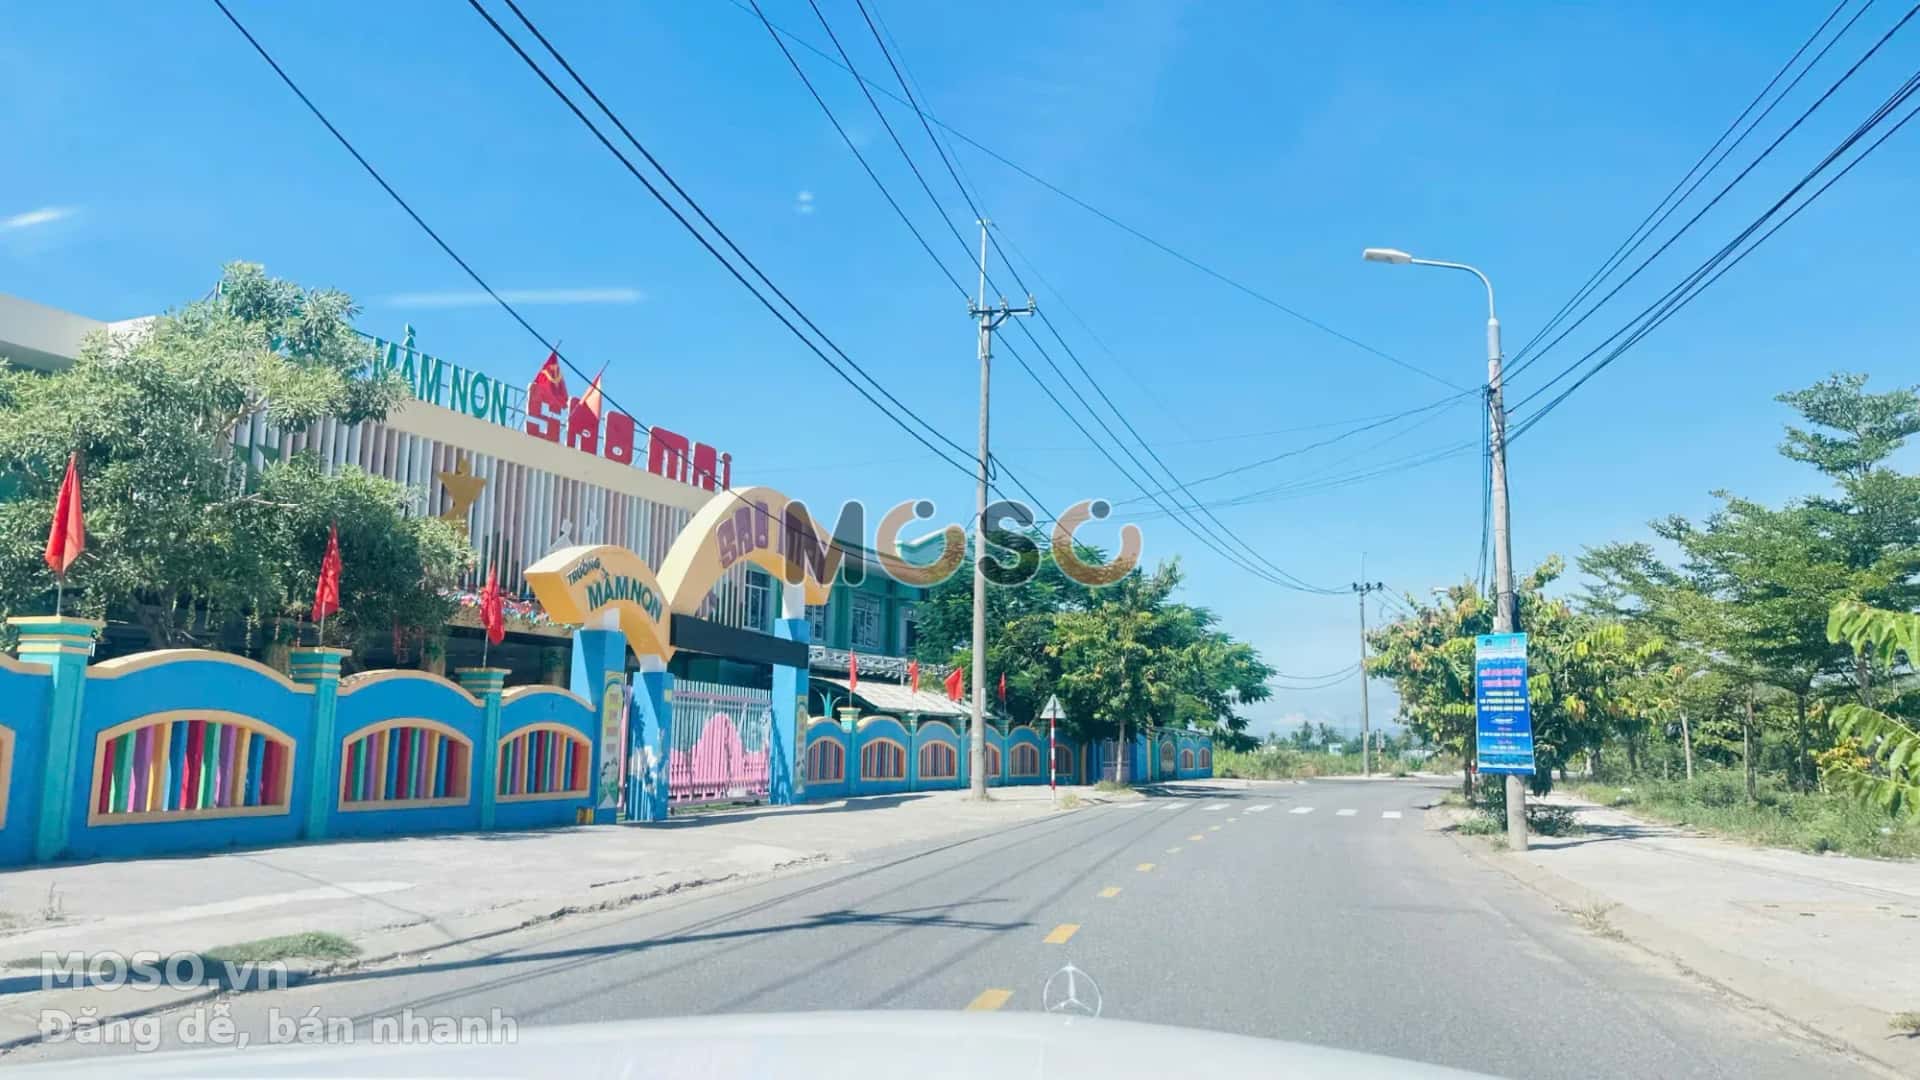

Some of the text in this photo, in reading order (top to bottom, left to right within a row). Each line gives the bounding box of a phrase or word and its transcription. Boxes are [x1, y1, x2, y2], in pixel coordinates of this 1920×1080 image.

[449, 363, 509, 427] NON
[525, 380, 635, 466] SAO
[630, 577, 662, 625] NON
